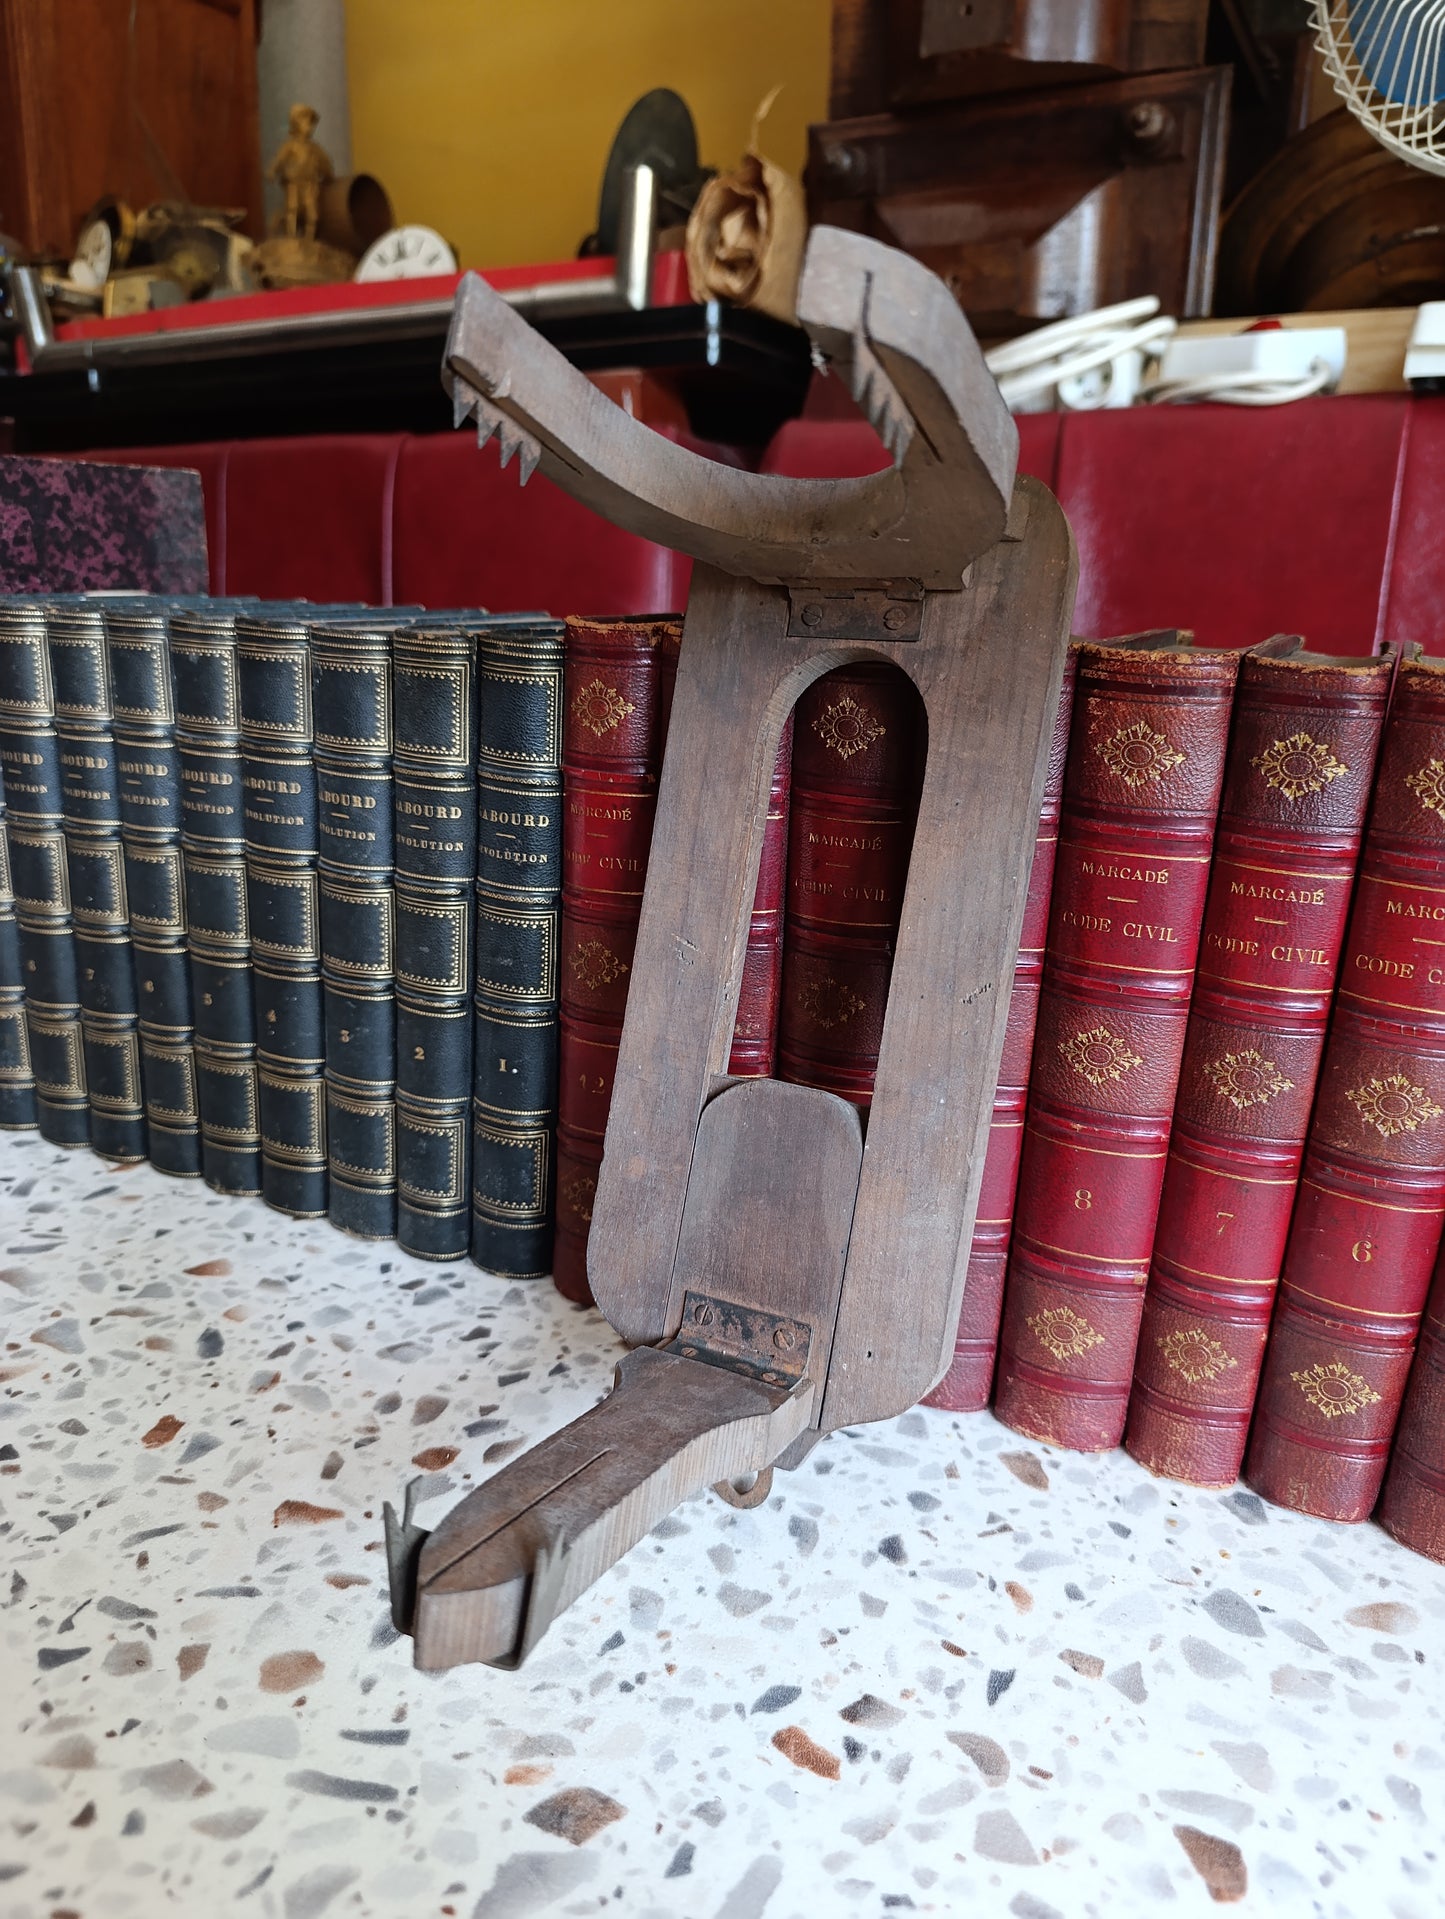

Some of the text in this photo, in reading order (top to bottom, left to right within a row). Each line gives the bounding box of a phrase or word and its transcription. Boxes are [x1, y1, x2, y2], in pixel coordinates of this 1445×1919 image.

[570, 803, 632, 821] MARCADÉ
[808, 832, 883, 851] MARCADÉ
[599, 857, 643, 872] CIVIL
[1081, 861, 1169, 884] MARCADÉ
[843, 887, 891, 902] CIVIL
[1230, 881, 1325, 905] MARCADÉ
[1386, 900, 1445, 921] MARC
[1063, 910, 1178, 942] CODE CIVIL
[1207, 933, 1330, 965] CODE CIVIL
[1355, 954, 1445, 985] CODE C
[414, 1046, 425, 1060] 2
[1074, 1189, 1092, 1210] 8
[1216, 1212, 1235, 1236] 7
[1351, 1240, 1373, 1263] 6
